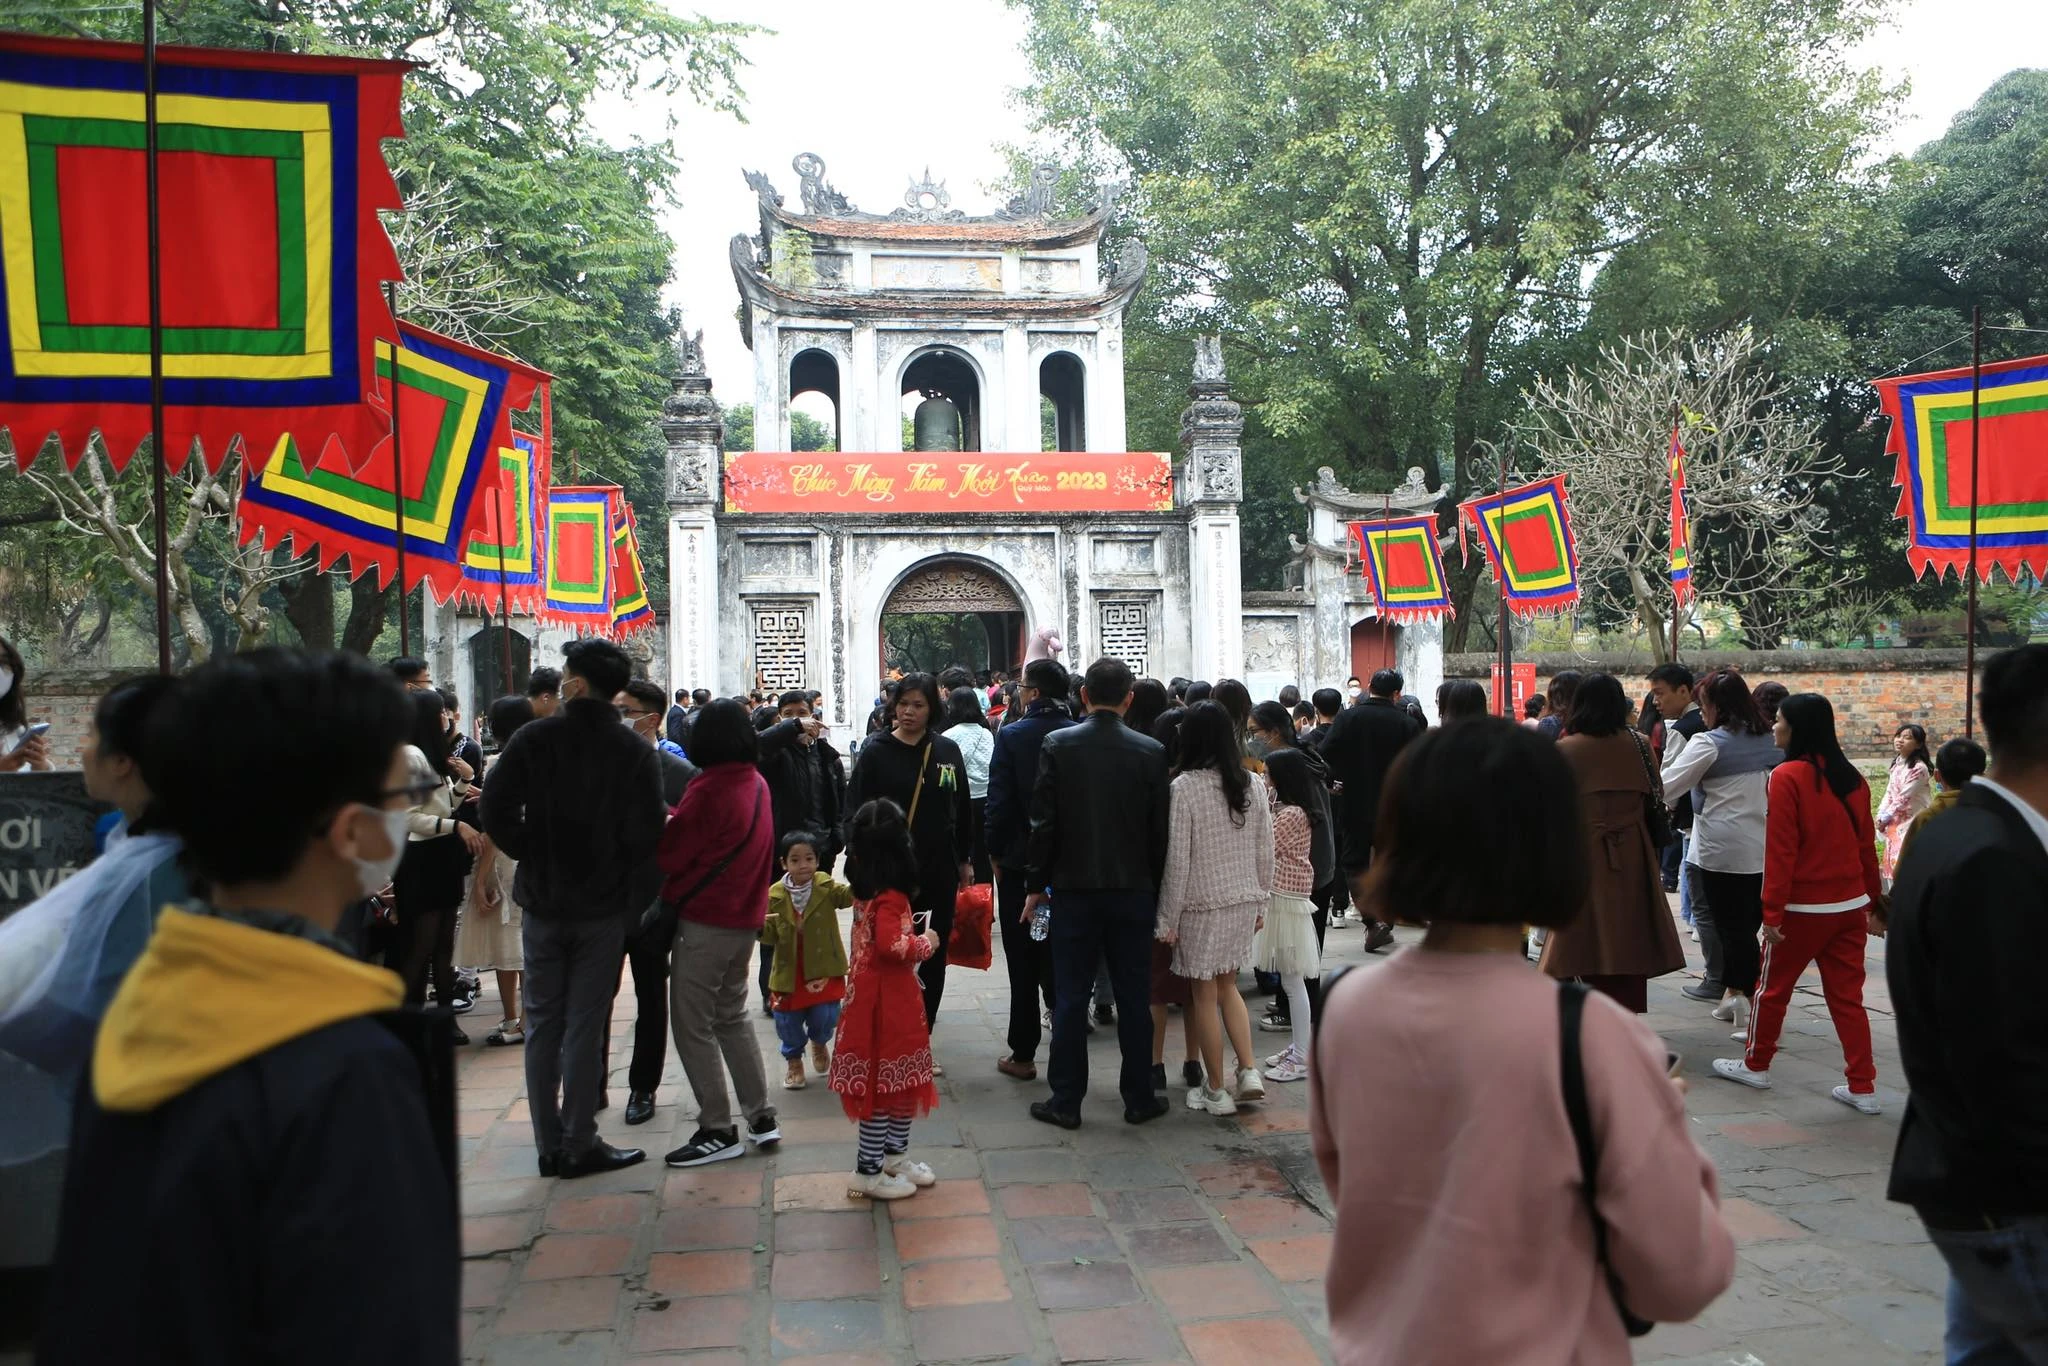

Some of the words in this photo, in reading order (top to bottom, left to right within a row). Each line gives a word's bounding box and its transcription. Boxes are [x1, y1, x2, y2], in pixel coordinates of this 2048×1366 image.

[789, 464, 838, 497] Chúc
[837, 463, 895, 502] Mừng
[904, 463, 948, 492] Năm
[948, 463, 1006, 498] Mới
[1004, 460, 1049, 503] Xuân
[1056, 471, 1108, 491] 2023
